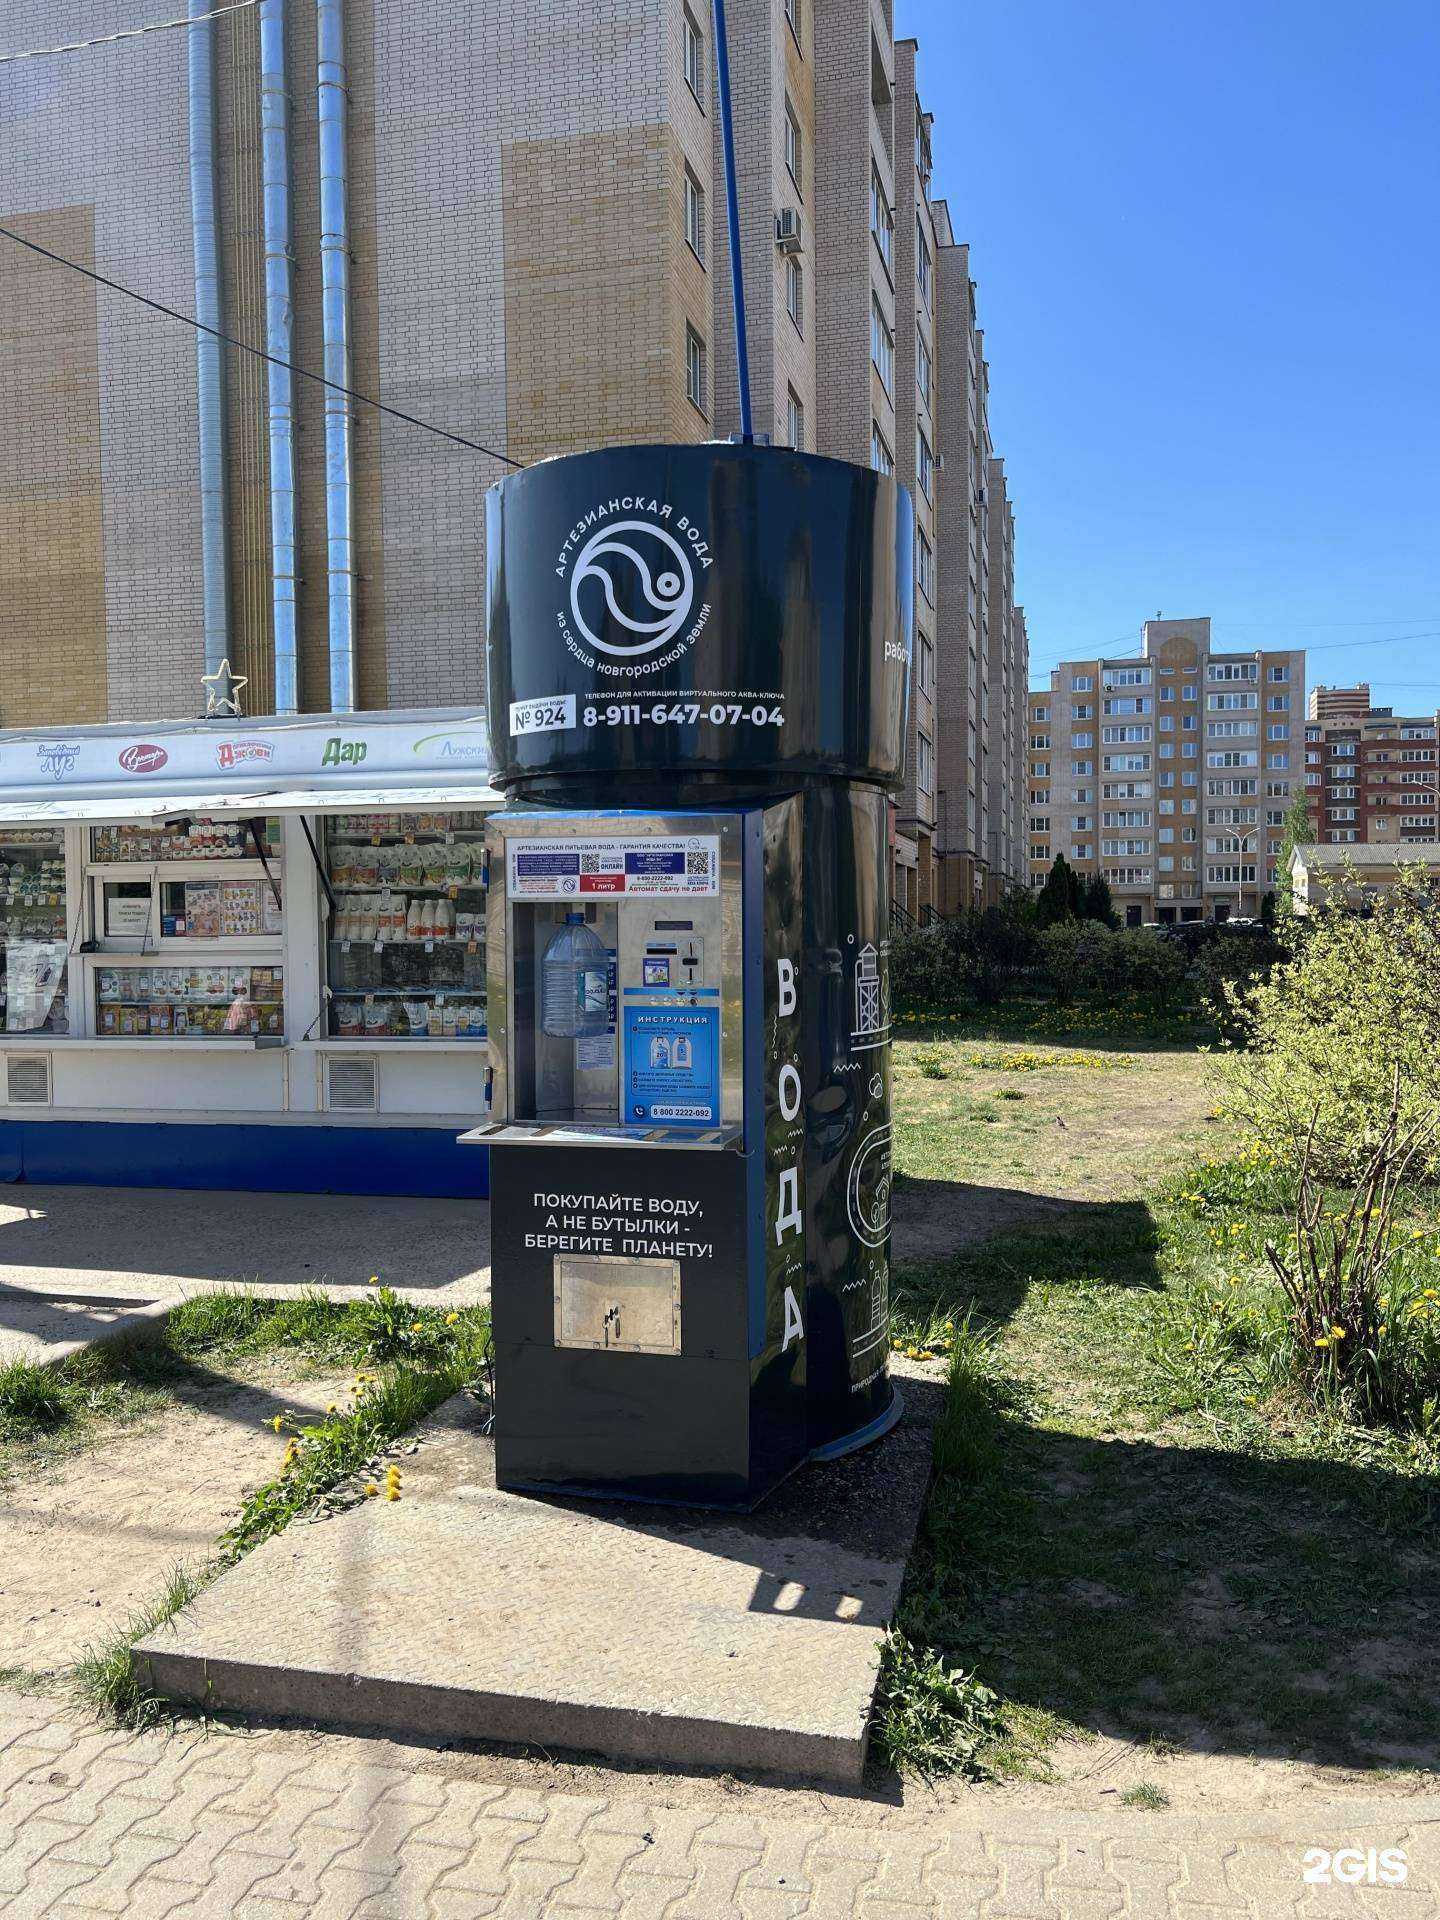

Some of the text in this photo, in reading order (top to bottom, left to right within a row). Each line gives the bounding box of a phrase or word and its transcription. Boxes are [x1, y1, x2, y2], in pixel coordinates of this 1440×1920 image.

[556, 497, 713, 578] АРТЕЗИАНСКАЯ ВОДА
[557, 603, 712, 678] из сердца новгородской земли
[585, 690, 785, 700] ТЕЛЕФОН ДЛЯ АКТИВАЦИИ ВИРТУАЛЬНОГО АКВА-КЛЮЧА
[515, 706, 566, 730] № 924
[583, 704, 785, 727] 8-911-647-07-04
[321, 737, 368, 766] Дар
[596, 883, 616, 891] литр
[638, 1016, 708, 1024] ИНСТРУКЦИЯ
[660, 1108, 674, 1116] 800
[675, 1109, 709, 1117] 2222-092
[533, 1193, 704, 1217] ПОКУПАЙТЕ ВОДУ,
[545, 1215, 558, 1228] А
[563, 1216, 587, 1229] НЕ
[592, 1217, 679, 1235] БУТЫЛКИ
[525, 1234, 713, 1258] БЕРЕГИТЕ ПЛАНЕТУ!
